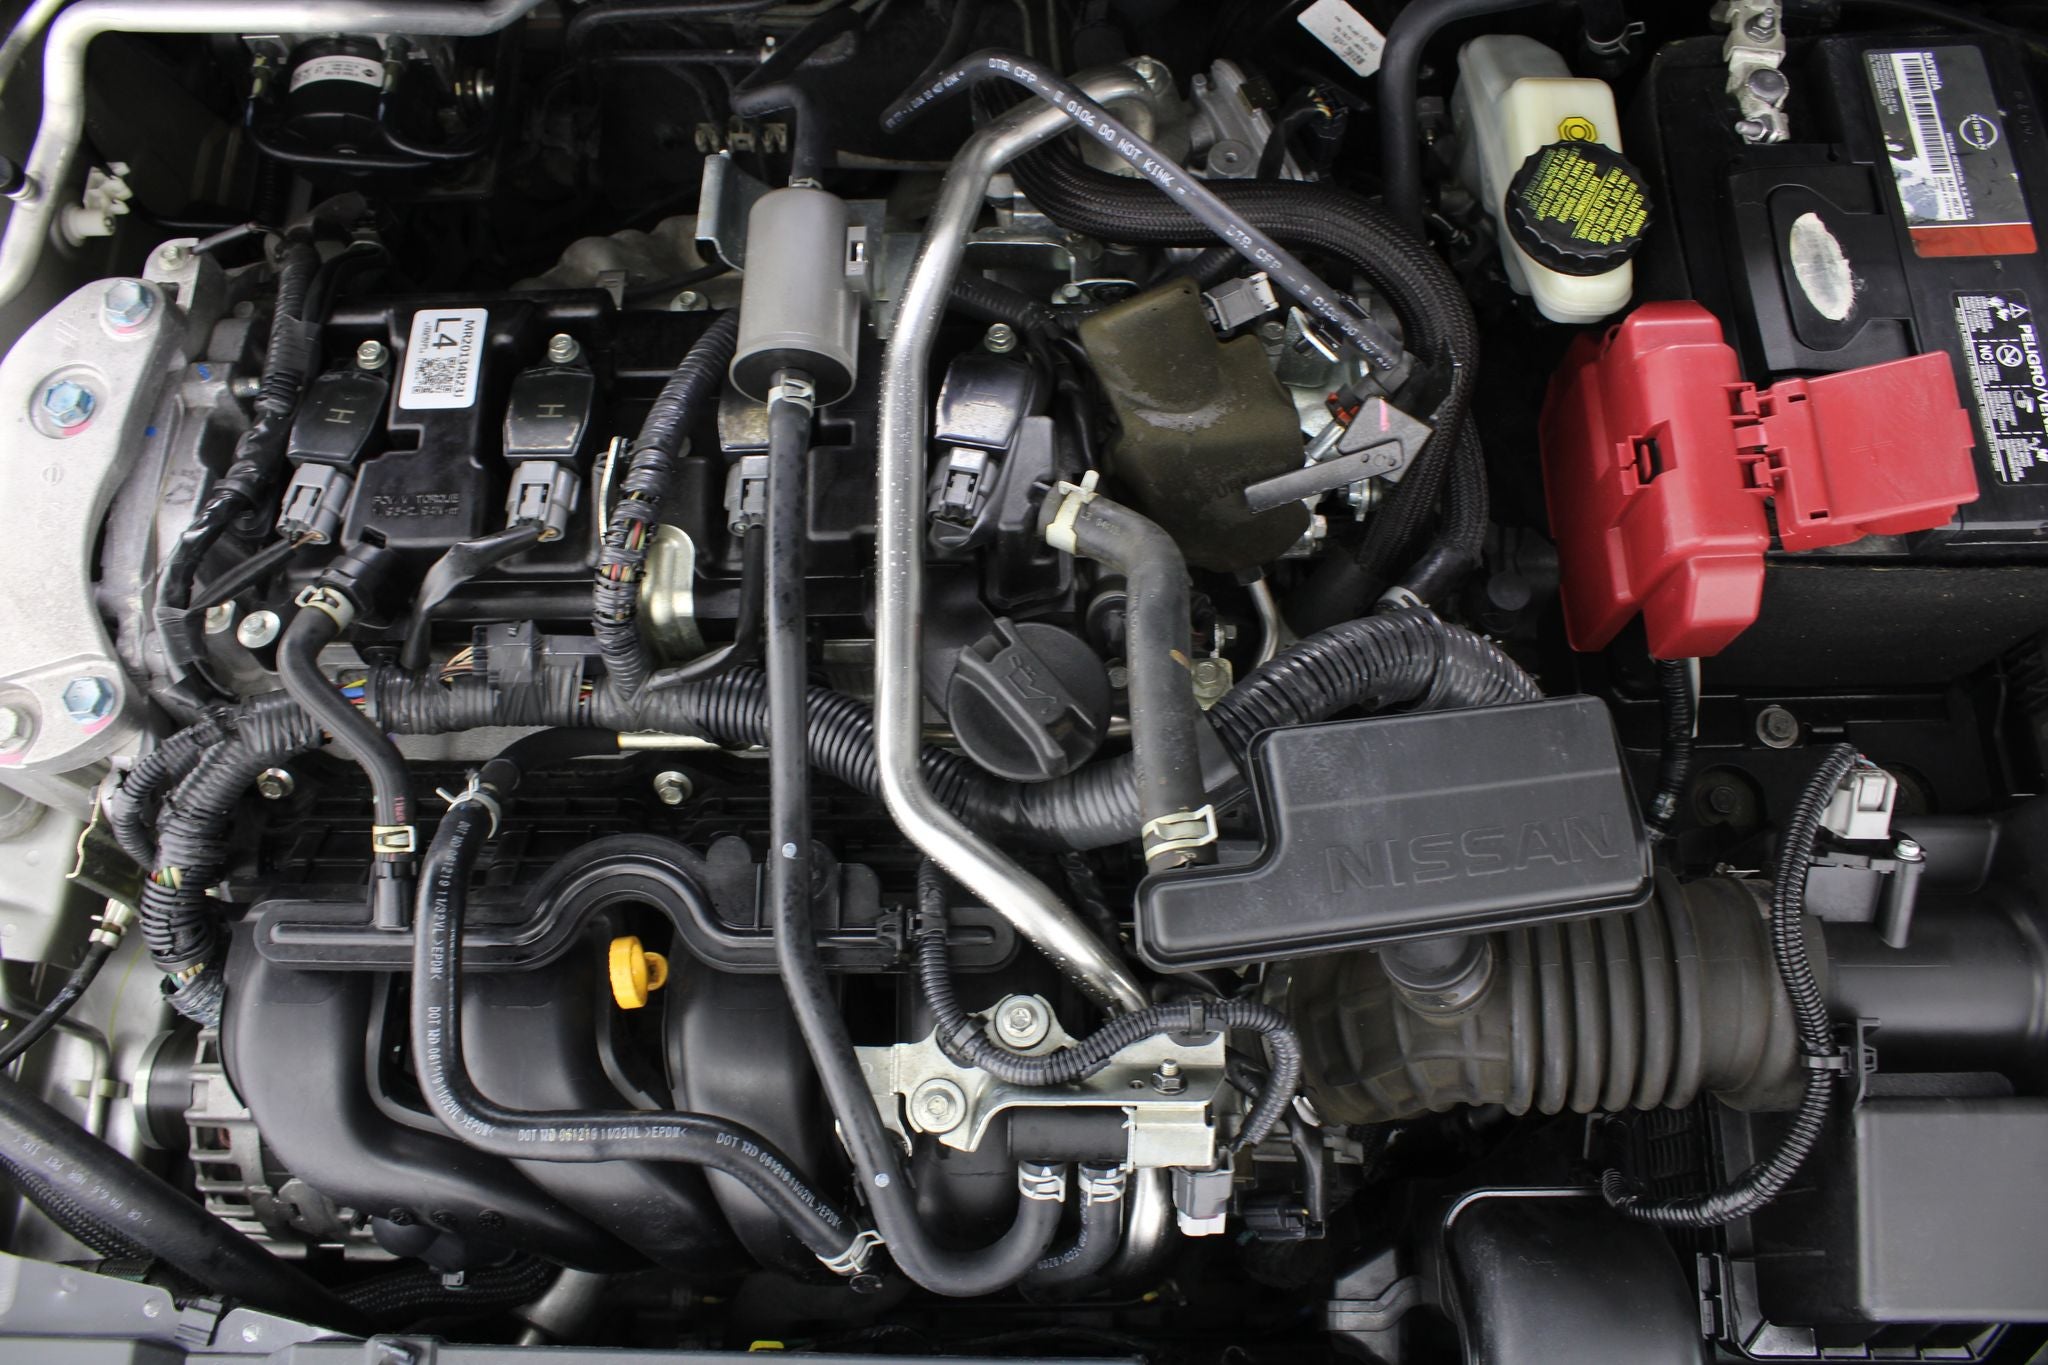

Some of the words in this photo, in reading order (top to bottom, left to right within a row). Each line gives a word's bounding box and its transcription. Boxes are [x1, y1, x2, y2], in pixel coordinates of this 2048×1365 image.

[1921, 51, 1944, 91] BATERÍA
[1968, 113, 1988, 150] NISSAN
[1117, 138, 1142, 160] NOT
[1142, 159, 1176, 187] KINK
[1569, 157, 1586, 178] AVANT
[1564, 175, 1576, 187] DE
[1574, 160, 1597, 191] NETTOYER
[1606, 165, 1623, 185] FROM
[1560, 183, 1572, 194] LE
[1569, 188, 1581, 199] LE
[1592, 186, 1611, 210] SEALED
[1608, 187, 1623, 203] DOT
[1619, 180, 1638, 205] BEFORE
[1627, 191, 1645, 213] CLEAN
[1595, 205, 1613, 228] BRAKE
[1617, 209, 1635, 232] FILLER
[1625, 207, 1648, 239] WARNING:
[1586, 223, 1603, 244] FLUID
[1597, 230, 1612, 245] USE
[431, 317, 462, 350] L4
[1323, 812, 1621, 895] NISSAN
[427, 1006, 441, 1024] DOT
[715, 1132, 739, 1149] DOT
[45, 1156, 64, 1171] PET
